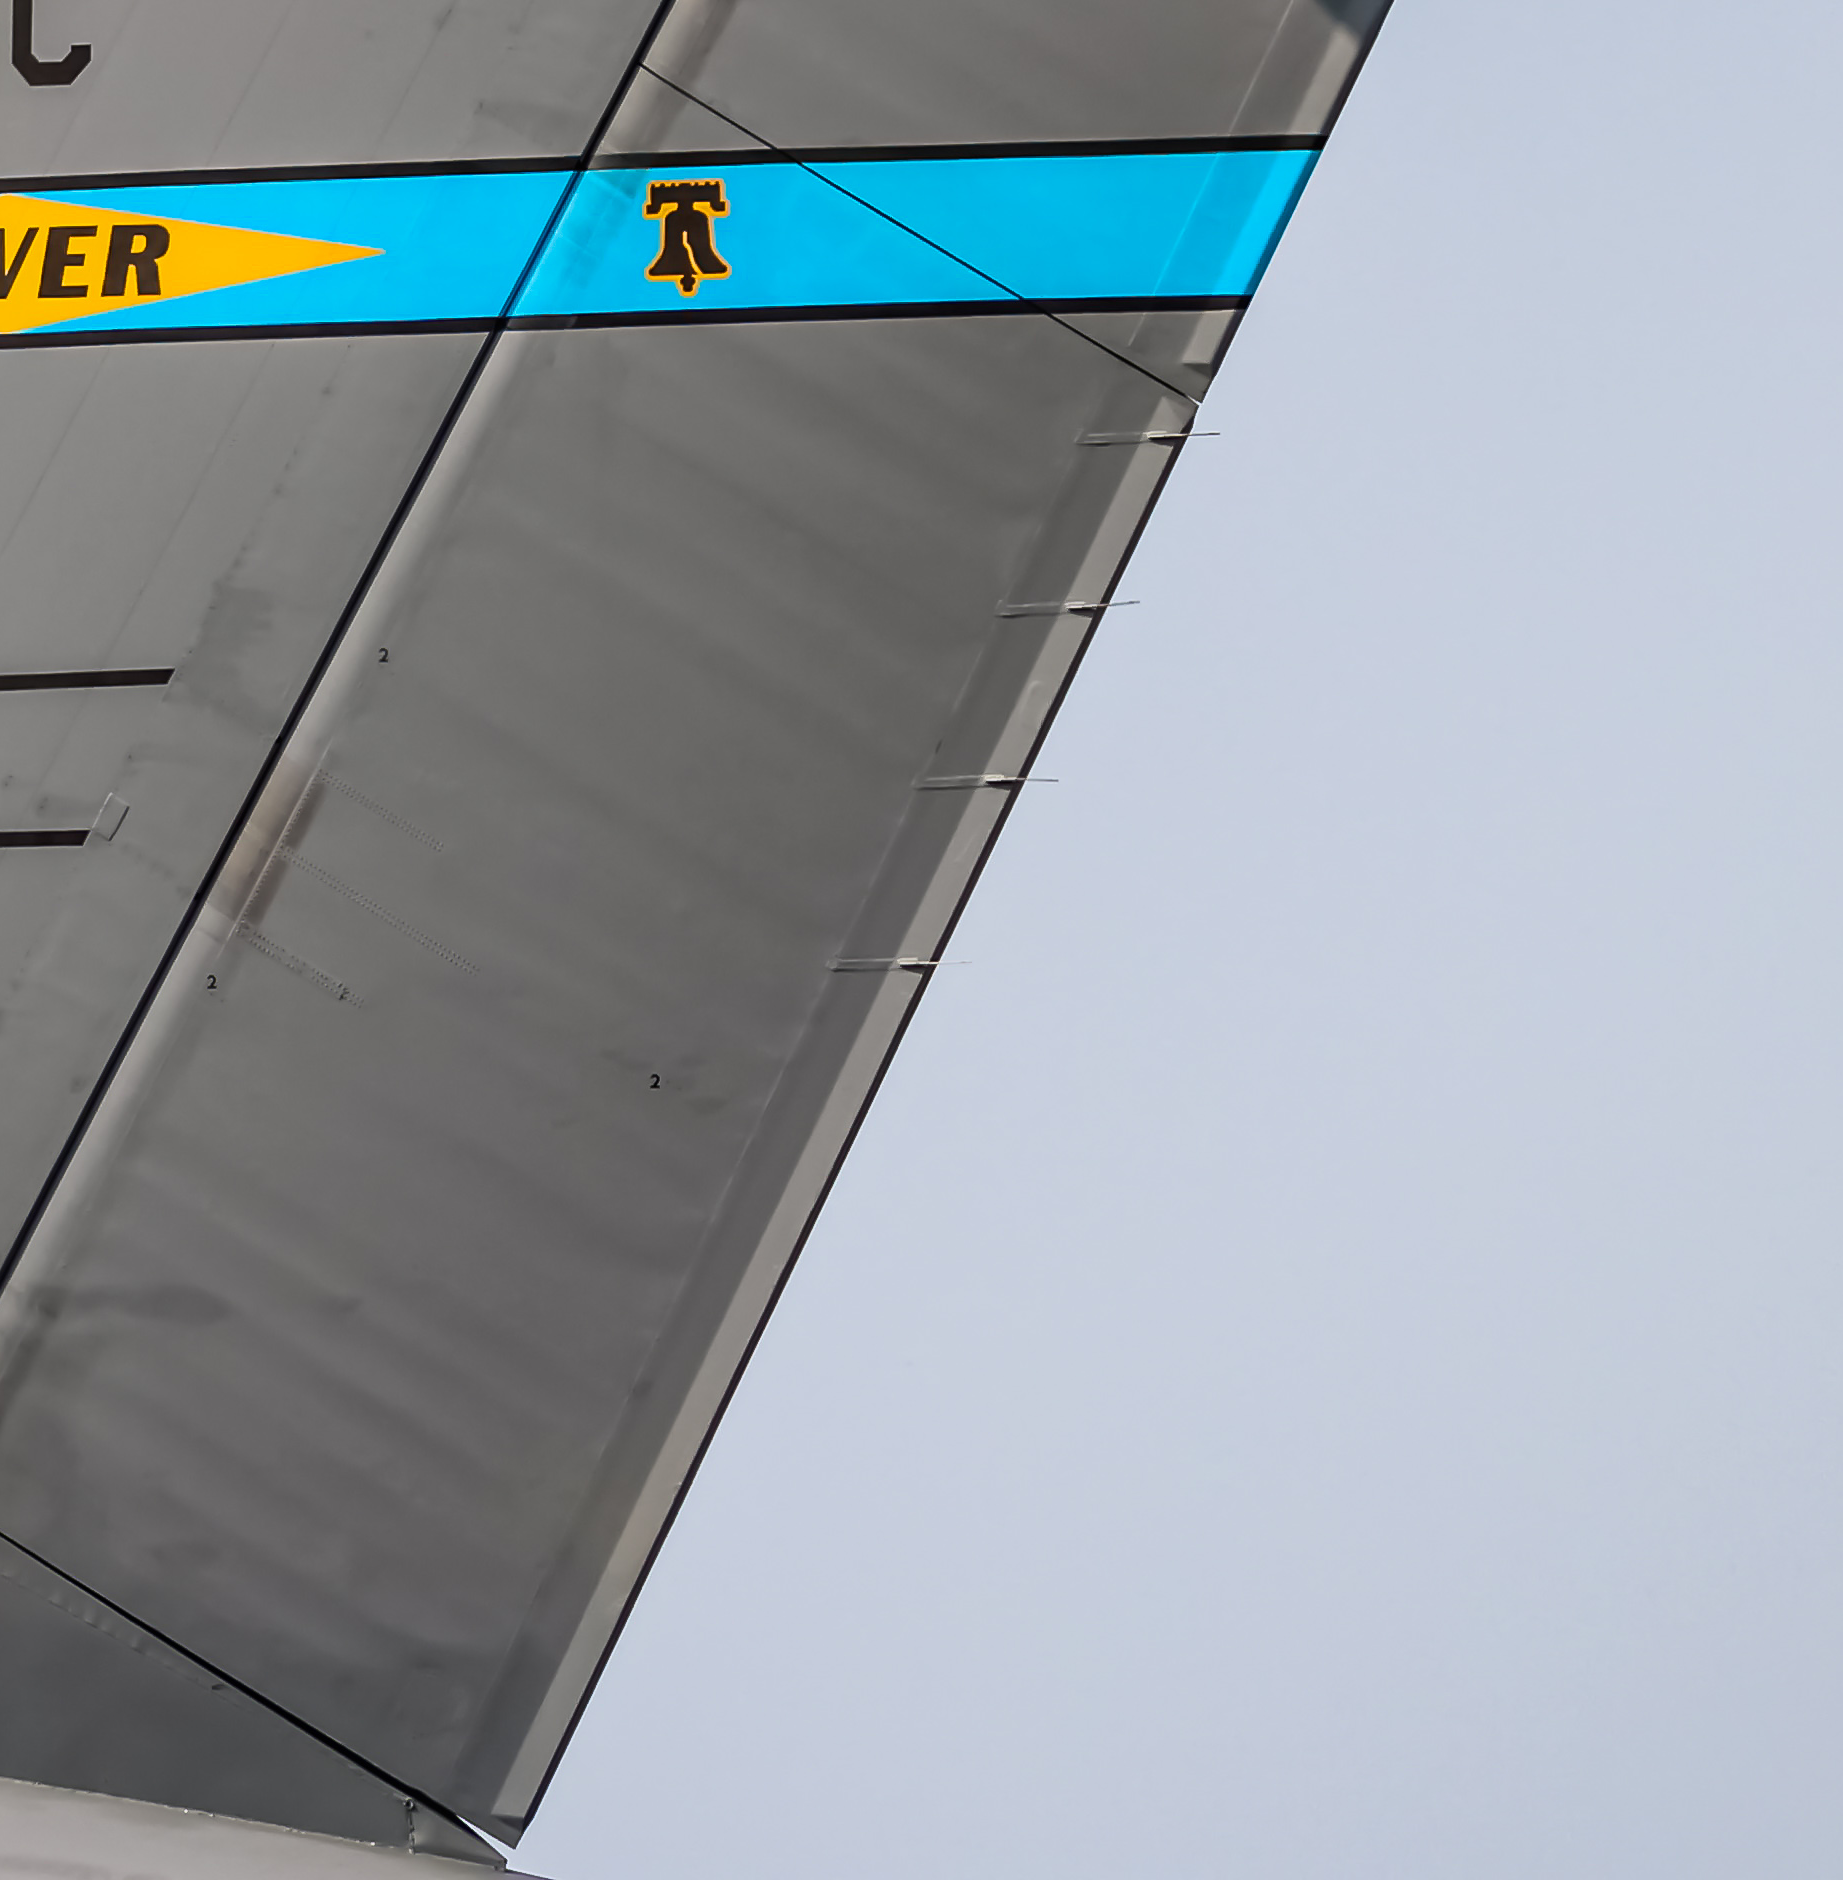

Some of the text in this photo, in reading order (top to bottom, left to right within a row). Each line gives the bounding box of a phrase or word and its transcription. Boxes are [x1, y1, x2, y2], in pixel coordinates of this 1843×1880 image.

[378, 647, 389, 663] 2
[206, 974, 218, 990] 2
[649, 1073, 661, 1089] 2
